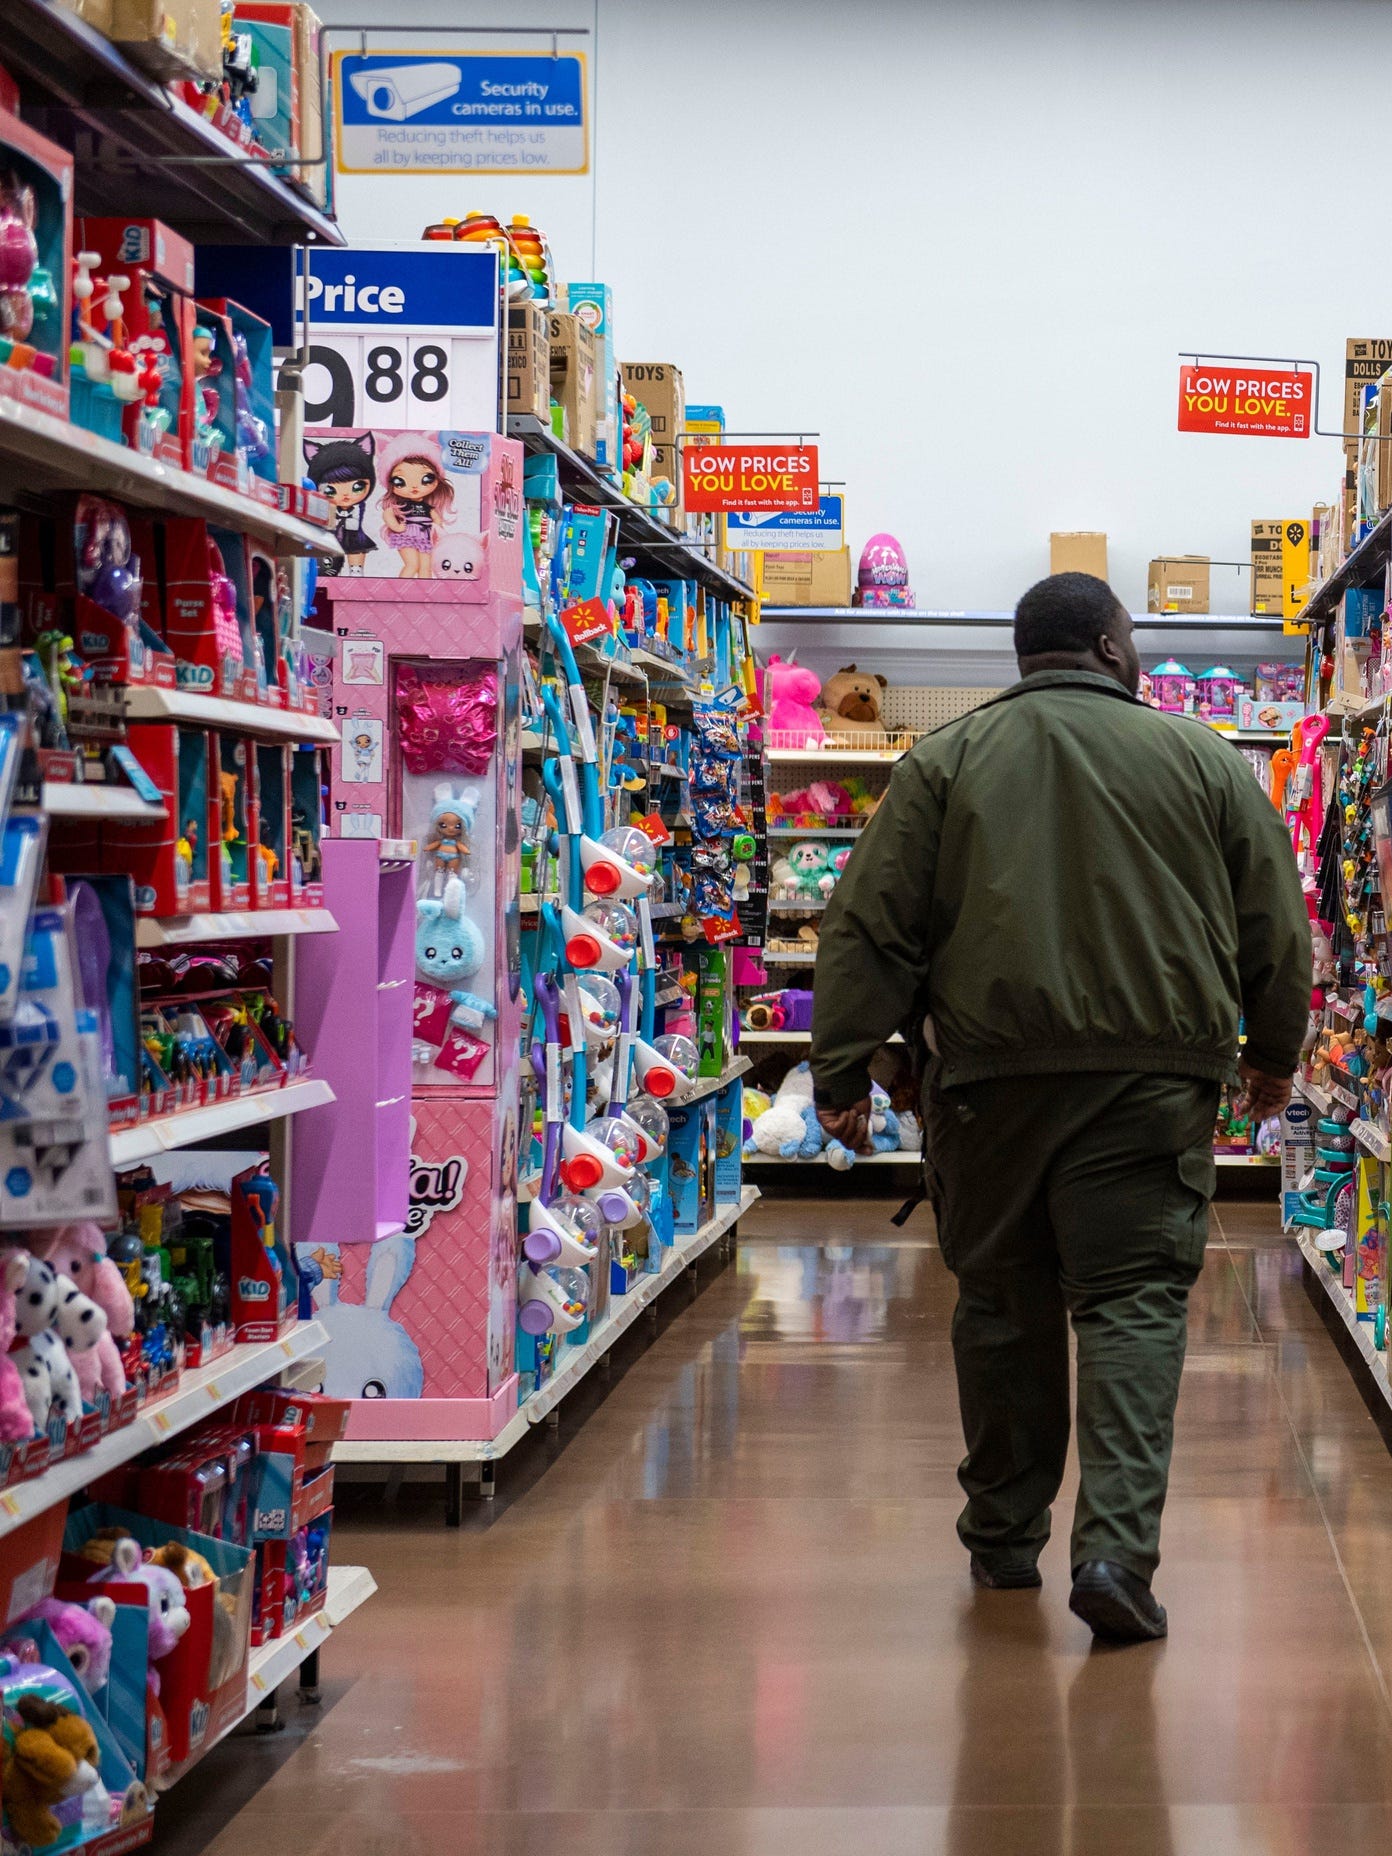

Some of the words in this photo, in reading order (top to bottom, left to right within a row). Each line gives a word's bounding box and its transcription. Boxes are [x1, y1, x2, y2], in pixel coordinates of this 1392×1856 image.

[480, 80, 549, 100] Security
[452, 103, 522, 116] cameras
[526, 100, 542, 116] in
[545, 103, 579, 116] use.
[378, 128, 447, 148] Reducing
[449, 128, 484, 145] theft
[487, 128, 528, 148] helps
[530, 132, 546, 145] us
[373, 150, 389, 164] all
[392, 150, 411, 168] by
[414, 150, 473, 168] keeping
[476, 151, 518, 168] prices
[521, 151, 551, 165] low.
[294, 275, 406, 313] Price
[365, 344, 449, 403] 88
[626, 365, 665, 381] TOYS
[1353, 363, 1381, 376] DOLLS
[1186, 377, 1231, 395] LOW
[1235, 379, 1304, 399] PRICES
[1184, 395, 1228, 414] YOU
[1234, 397, 1291, 417] LOVE.
[1215, 420, 1230, 428] Find
[1237, 421, 1249, 429] fast
[1250, 422, 1264, 430] with
[1265, 423, 1276, 431] the
[1277, 425, 1291, 433] app.
[449, 439, 484, 452] Collect
[451, 449, 480, 461] Them
[455, 458, 473, 468] All!
[690, 456, 736, 474] LOW
[741, 456, 811, 474] PRICES
[690, 474, 734, 492] YOU
[741, 474, 799, 492] LOVE.
[738, 498, 743, 506] it
[758, 498, 772, 506] with
[774, 498, 784, 506] the
[786, 500, 799, 509] app.
[779, 518, 813, 526] cameras
[814, 517, 822, 525] in
[823, 518, 840, 526] use.
[744, 530, 777, 540] Reducing
[778, 530, 795, 539] theft
[796, 530, 815, 540] helps
[815, 531, 824, 539] us
[741, 540, 749, 548] all
[750, 540, 759, 549] by
[760, 540, 788, 550] keeping
[789, 540, 809, 550] prices
[175, 599, 204, 607] Purse
[180, 609, 198, 617] Set
[572, 623, 607, 642] Rollback
[176, 665, 213, 685] KID
[713, 928, 739, 942] Rollback
[1286, 1109, 1310, 1117] vtech
[240, 1280, 270, 1296] KID
